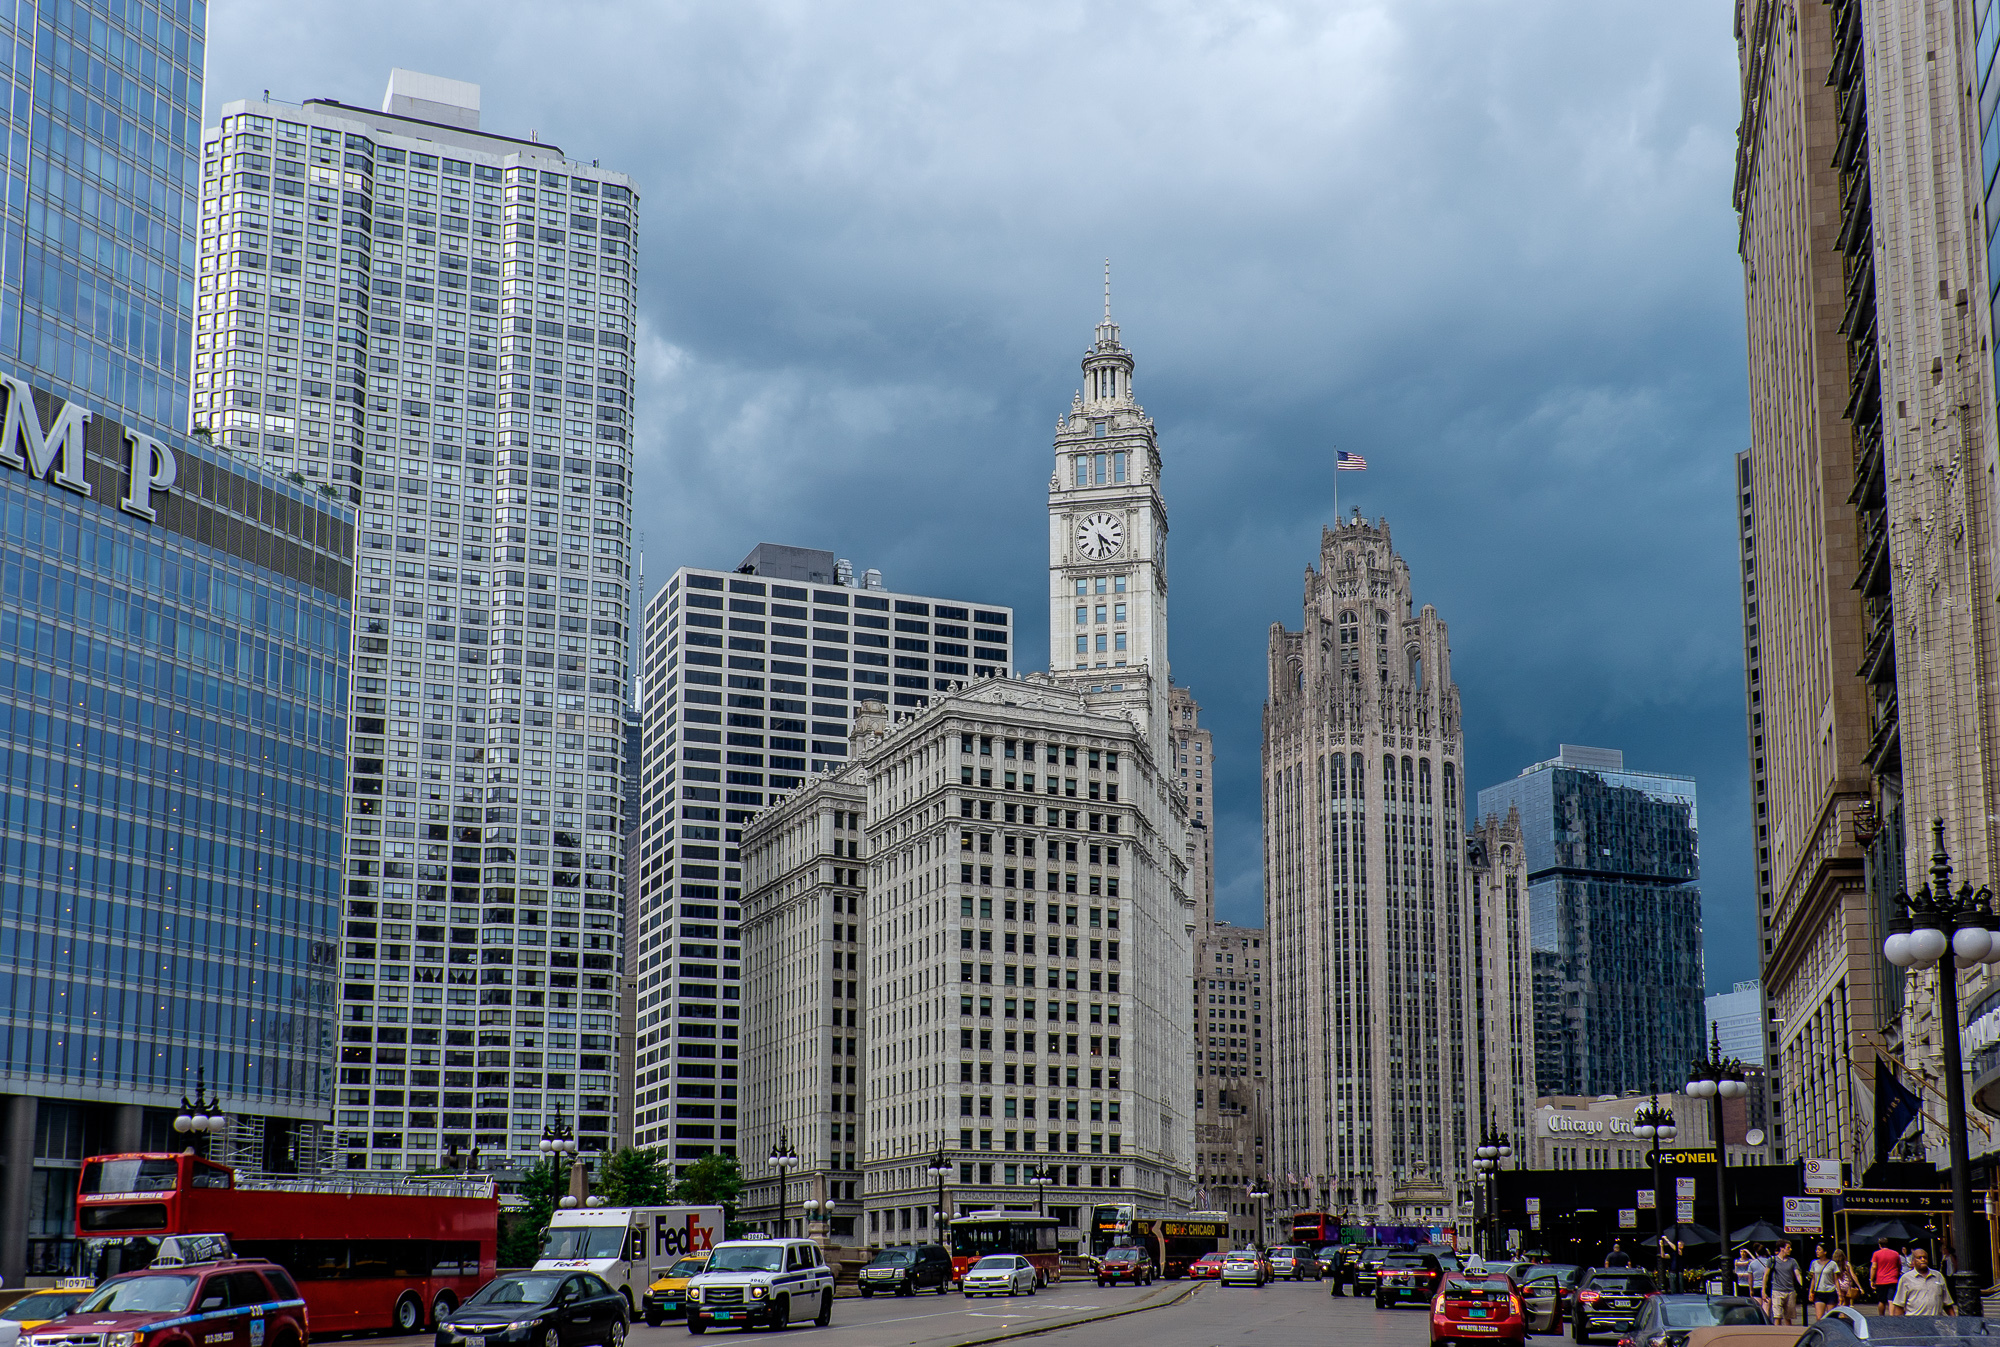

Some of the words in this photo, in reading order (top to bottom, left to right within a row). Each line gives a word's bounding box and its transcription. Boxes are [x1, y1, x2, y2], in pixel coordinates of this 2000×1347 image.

[1548, 1114, 1603, 1135] Chicago
[1188, 1224, 1216, 1236] CHICAGO
[1341, 1227, 1367, 1236] CRANK
[655, 1213, 714, 1257] FedEx
[1432, 1233, 1453, 1243] BLUE
[1341, 1236, 1352, 1245] UP
[553, 1260, 591, 1268] FedEx
[65, 1279, 86, 1288] 1097
[1496, 1294, 1510, 1302] 221
